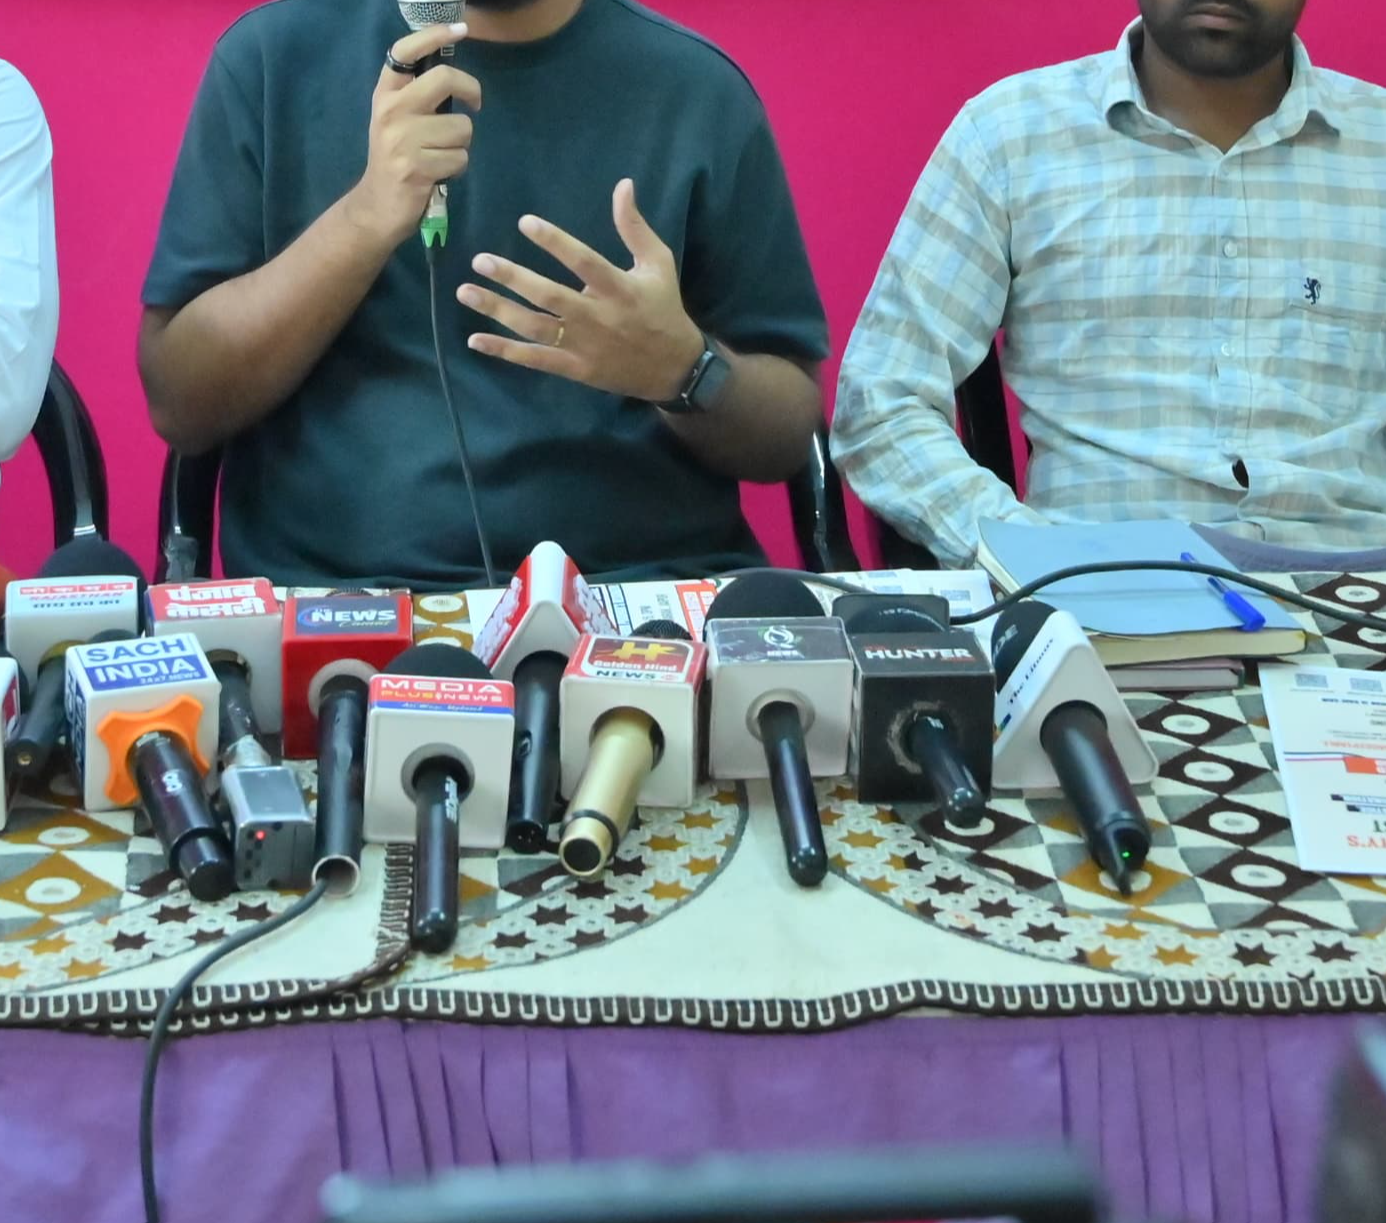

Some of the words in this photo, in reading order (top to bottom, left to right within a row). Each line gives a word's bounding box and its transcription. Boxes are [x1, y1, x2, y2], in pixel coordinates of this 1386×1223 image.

[311, 609, 397, 622] NEWS
[86, 638, 187, 663] SACH
[863, 647, 973, 660] HUNTER
[94, 657, 197, 684] INDIA
[596, 670, 656, 680] NEWS
[380, 679, 502, 694] MEDIA
[380, 690, 435, 700] PLUS
[443, 693, 503, 702] NEWS
